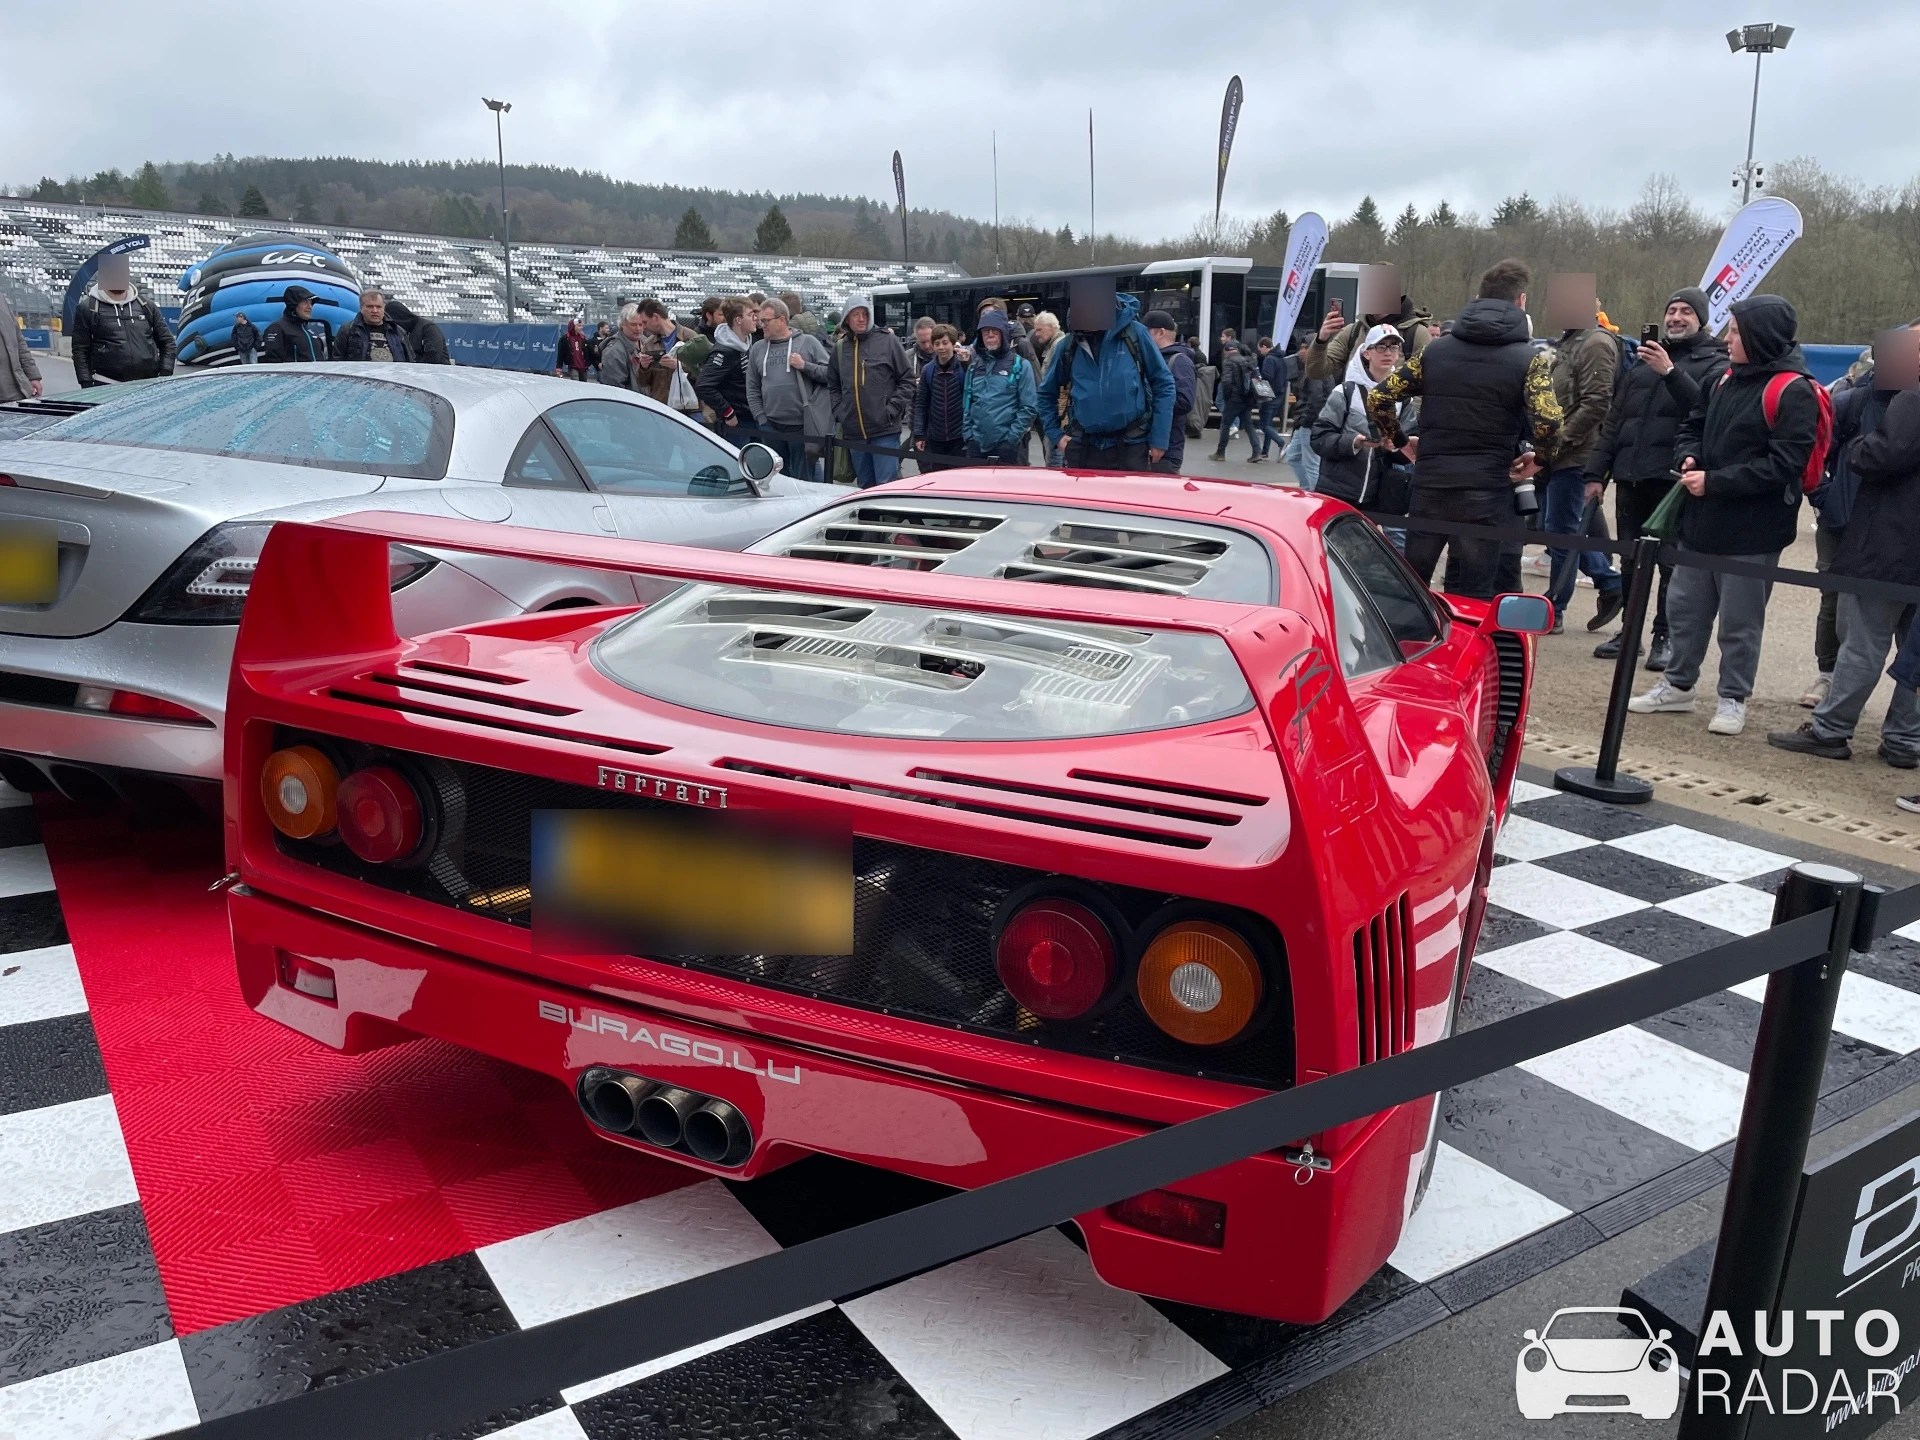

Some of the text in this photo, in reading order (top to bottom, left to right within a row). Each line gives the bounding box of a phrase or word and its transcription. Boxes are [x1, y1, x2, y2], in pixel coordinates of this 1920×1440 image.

[110, 239, 144, 254] SEE YOU
[261, 252, 326, 268] WEC
[1731, 226, 1763, 262] TOYOTA
[1736, 233, 1765, 268] GAZOO
[1740, 238, 1770, 272] Racing
[1709, 268, 1740, 307] GR
[1714, 229, 1795, 324] Cutomer Racing
[598, 765, 727, 809] Ferrari
[538, 1000, 801, 1084] BURAGO.LU
